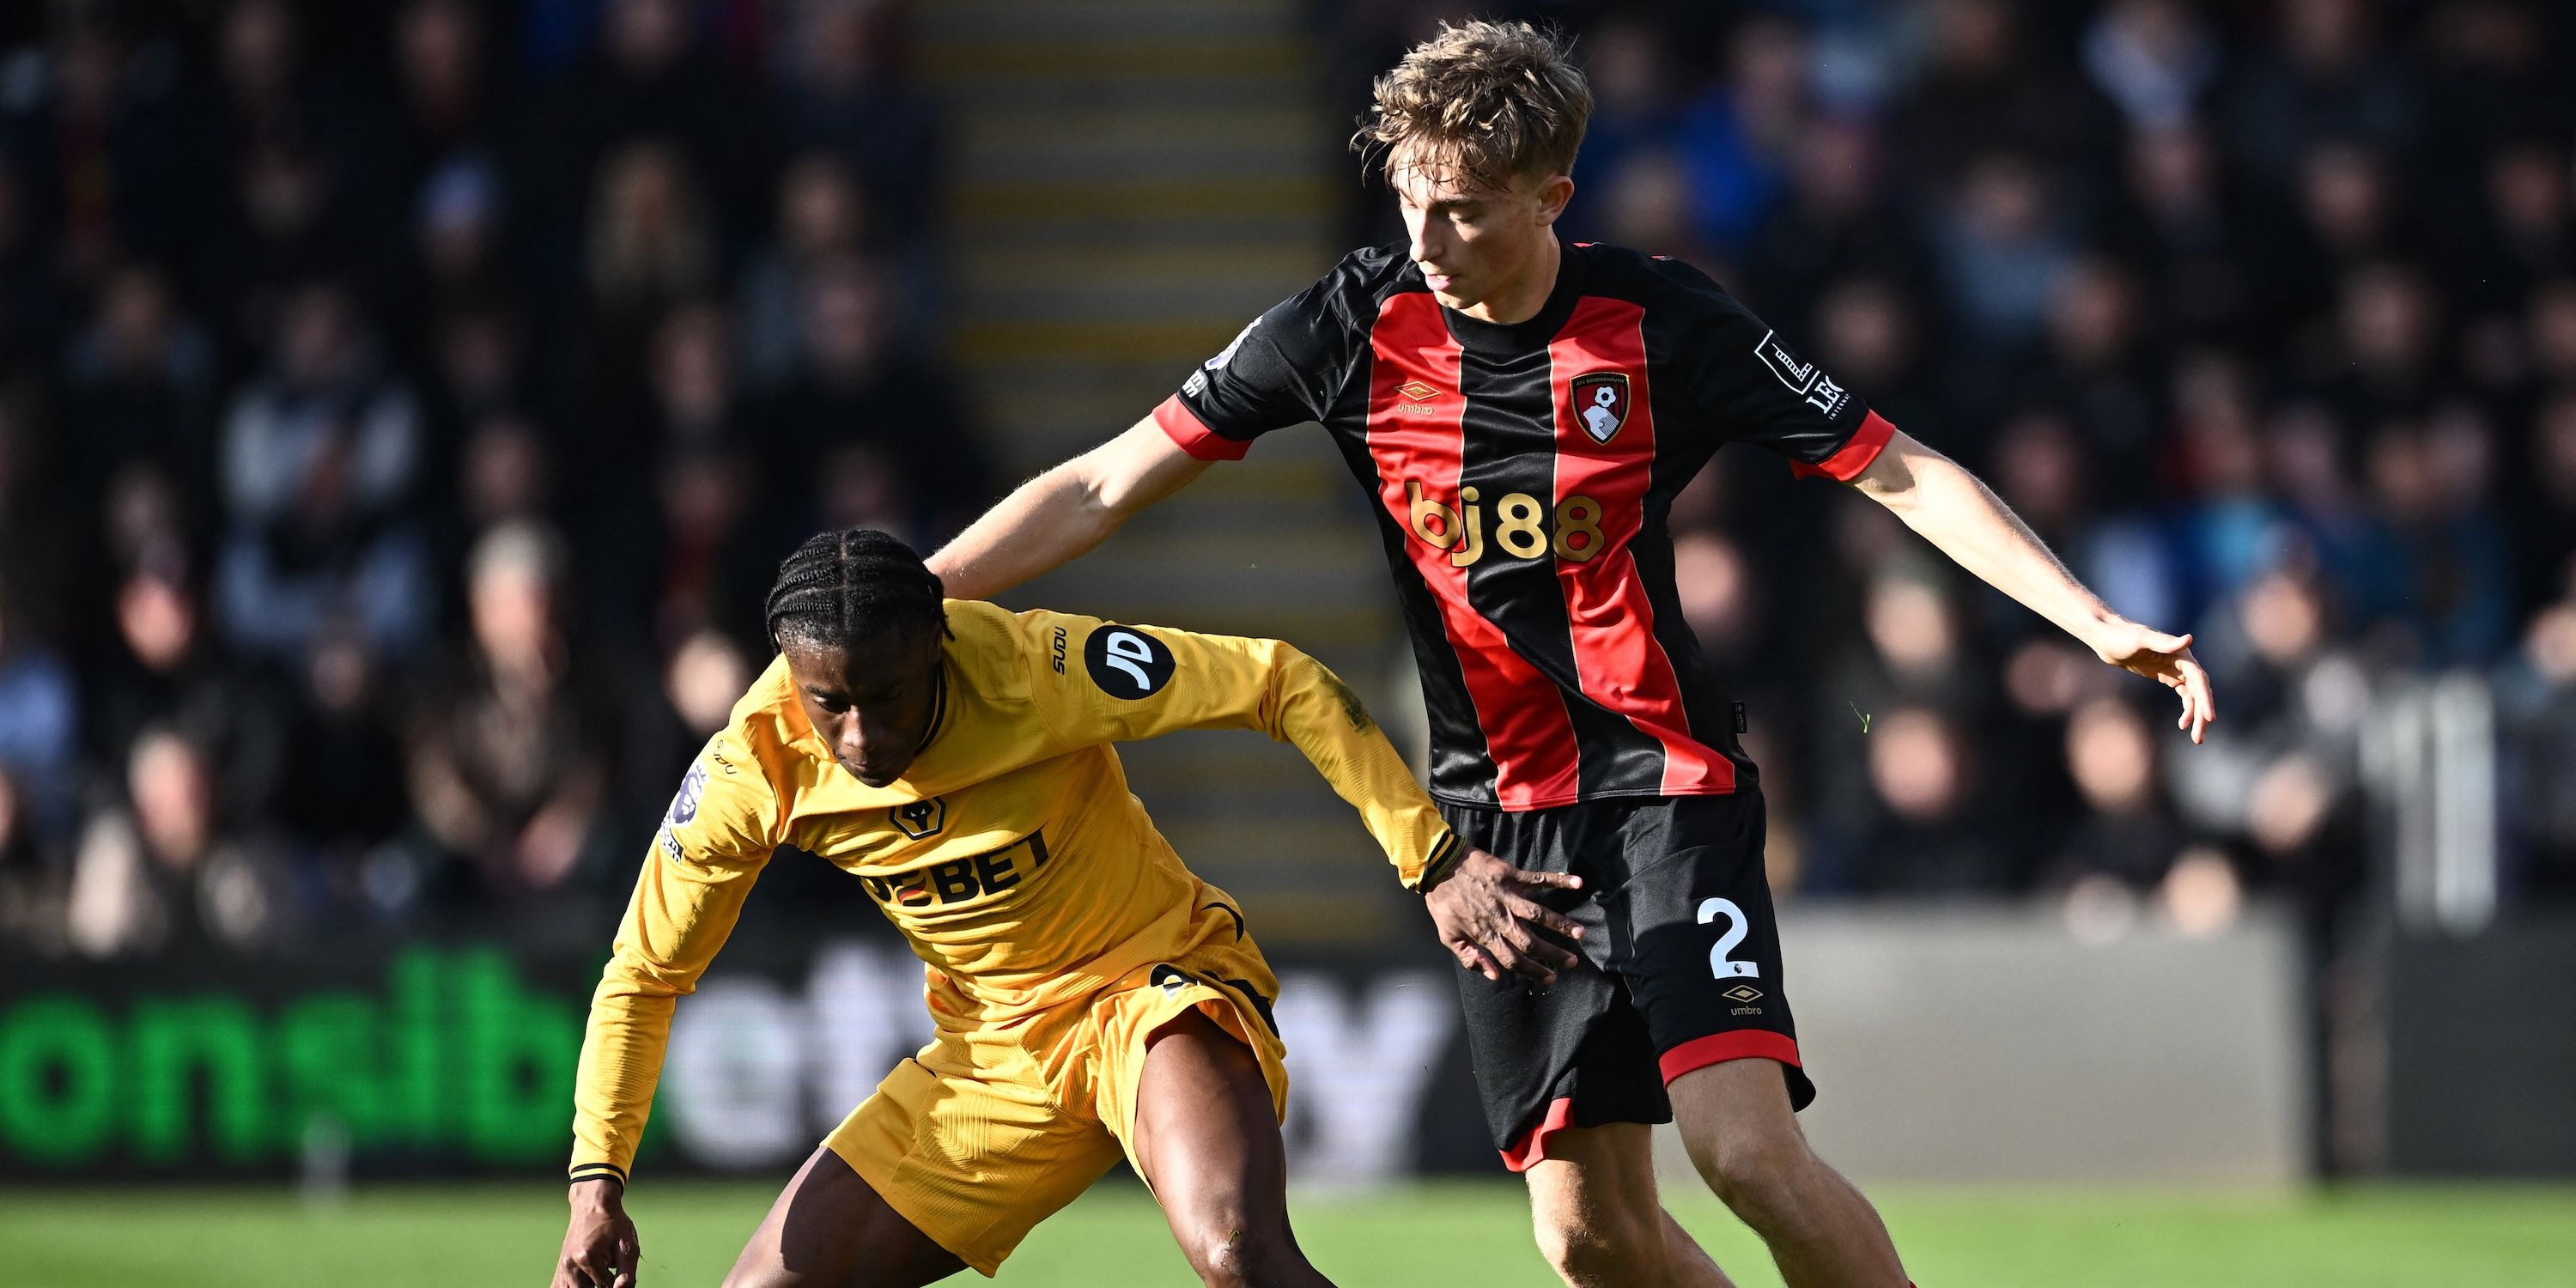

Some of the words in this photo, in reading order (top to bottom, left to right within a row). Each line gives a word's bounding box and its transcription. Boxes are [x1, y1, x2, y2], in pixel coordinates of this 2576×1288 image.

[1398, 403, 1435, 416] umbro
[1404, 480, 1606, 568] bj88
[1051, 626, 1067, 676] SUDU
[1105, 631, 1153, 691] JD
[1697, 896, 1760, 980] 2
[1730, 1005, 1763, 1017] umbro
